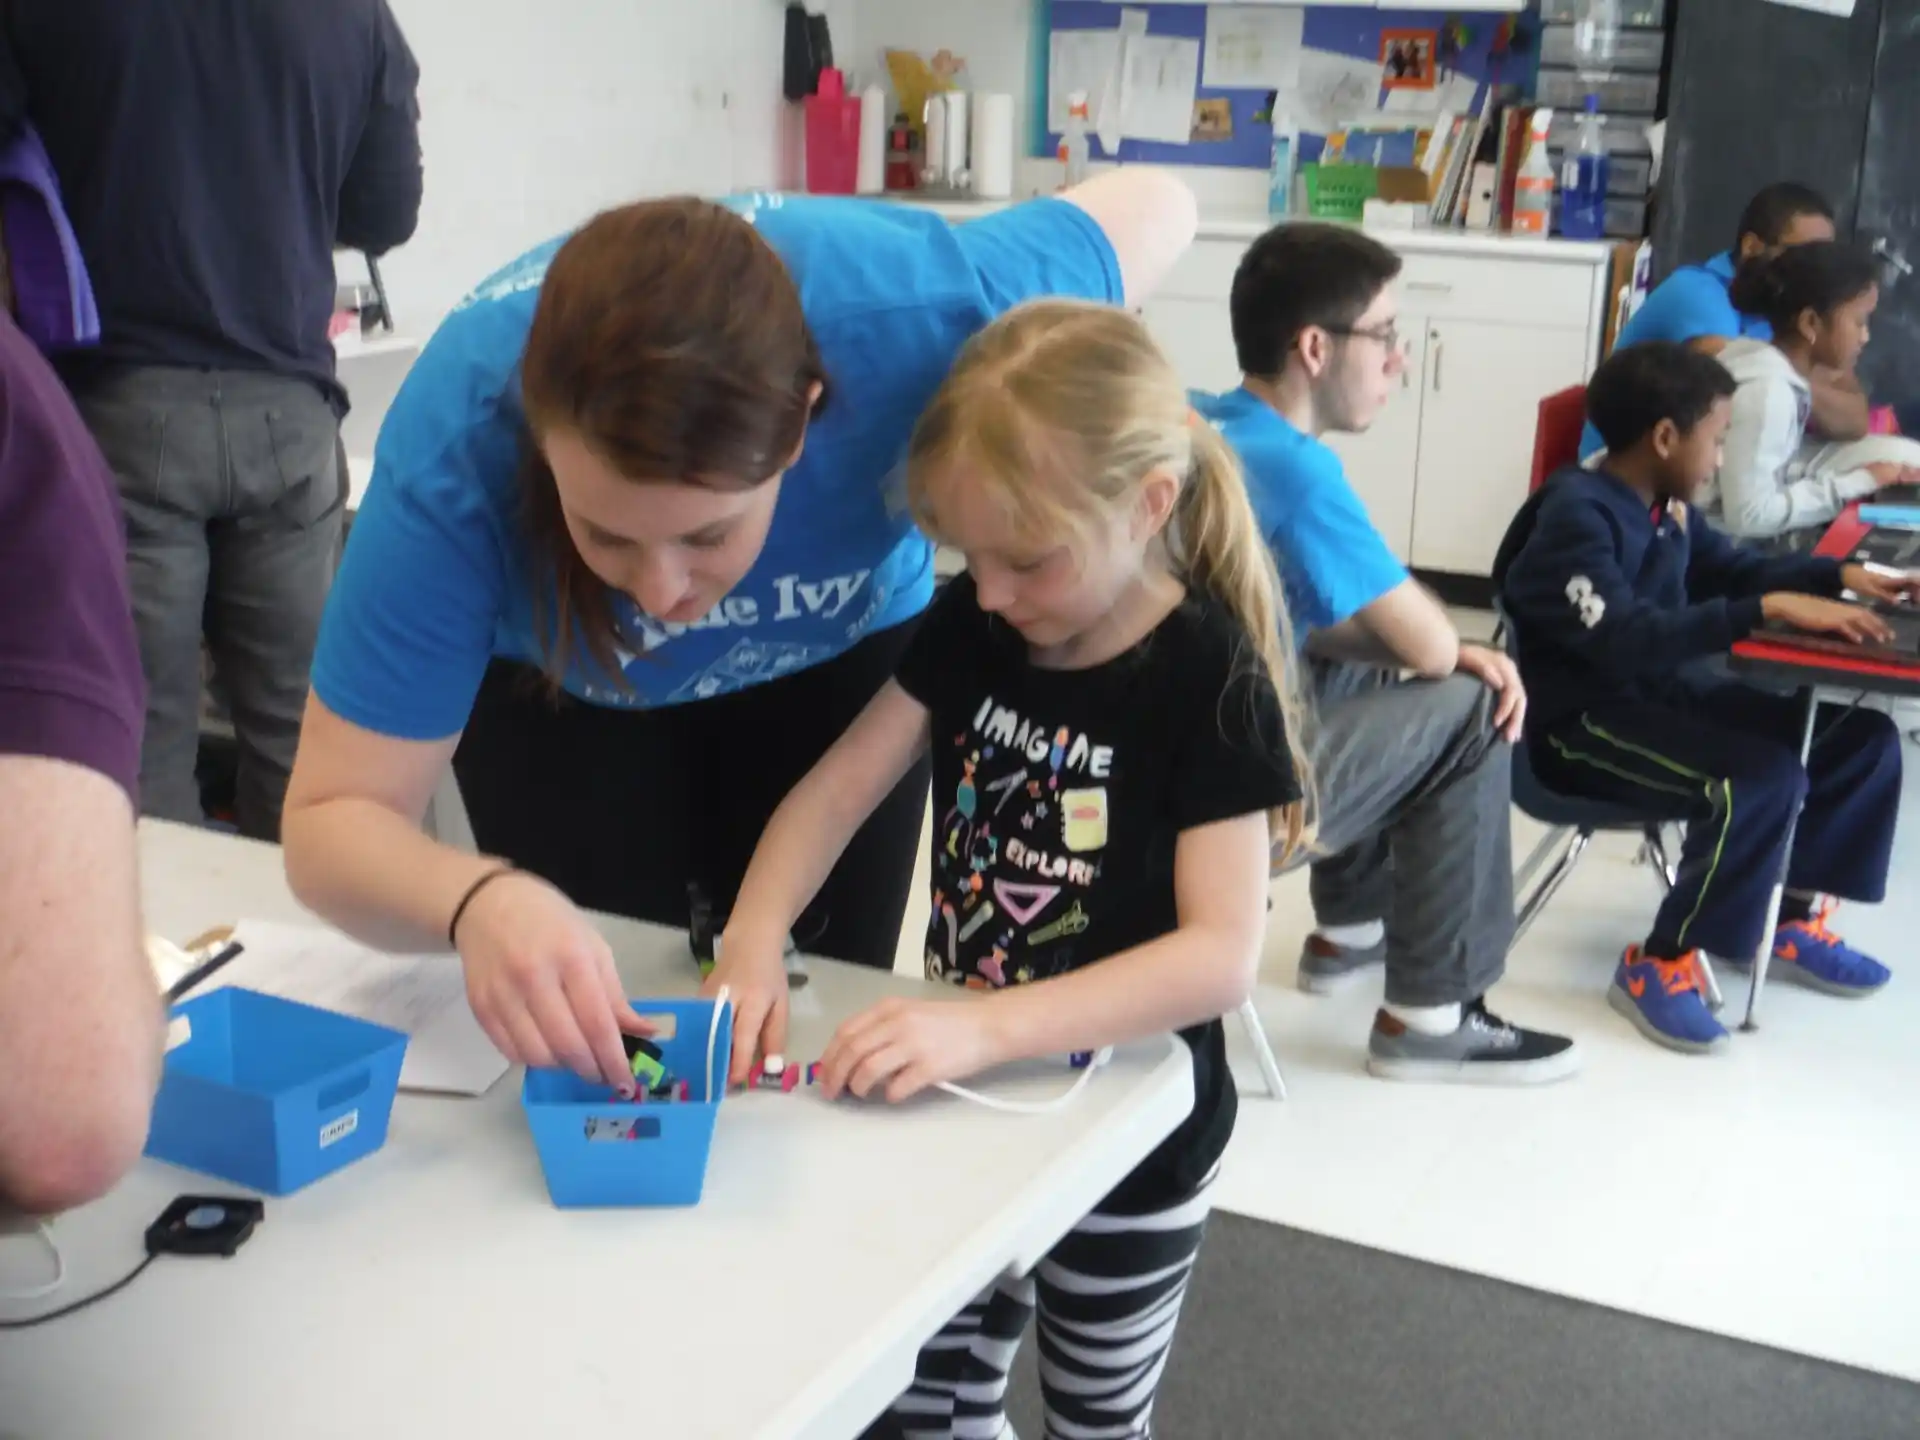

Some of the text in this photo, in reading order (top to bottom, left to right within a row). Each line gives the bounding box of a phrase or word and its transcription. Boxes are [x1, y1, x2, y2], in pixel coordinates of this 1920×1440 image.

[773, 568, 871, 621] Ivy
[973, 696, 1114, 778] IMAGINE
[1005, 837, 1095, 887] EXPLORE
